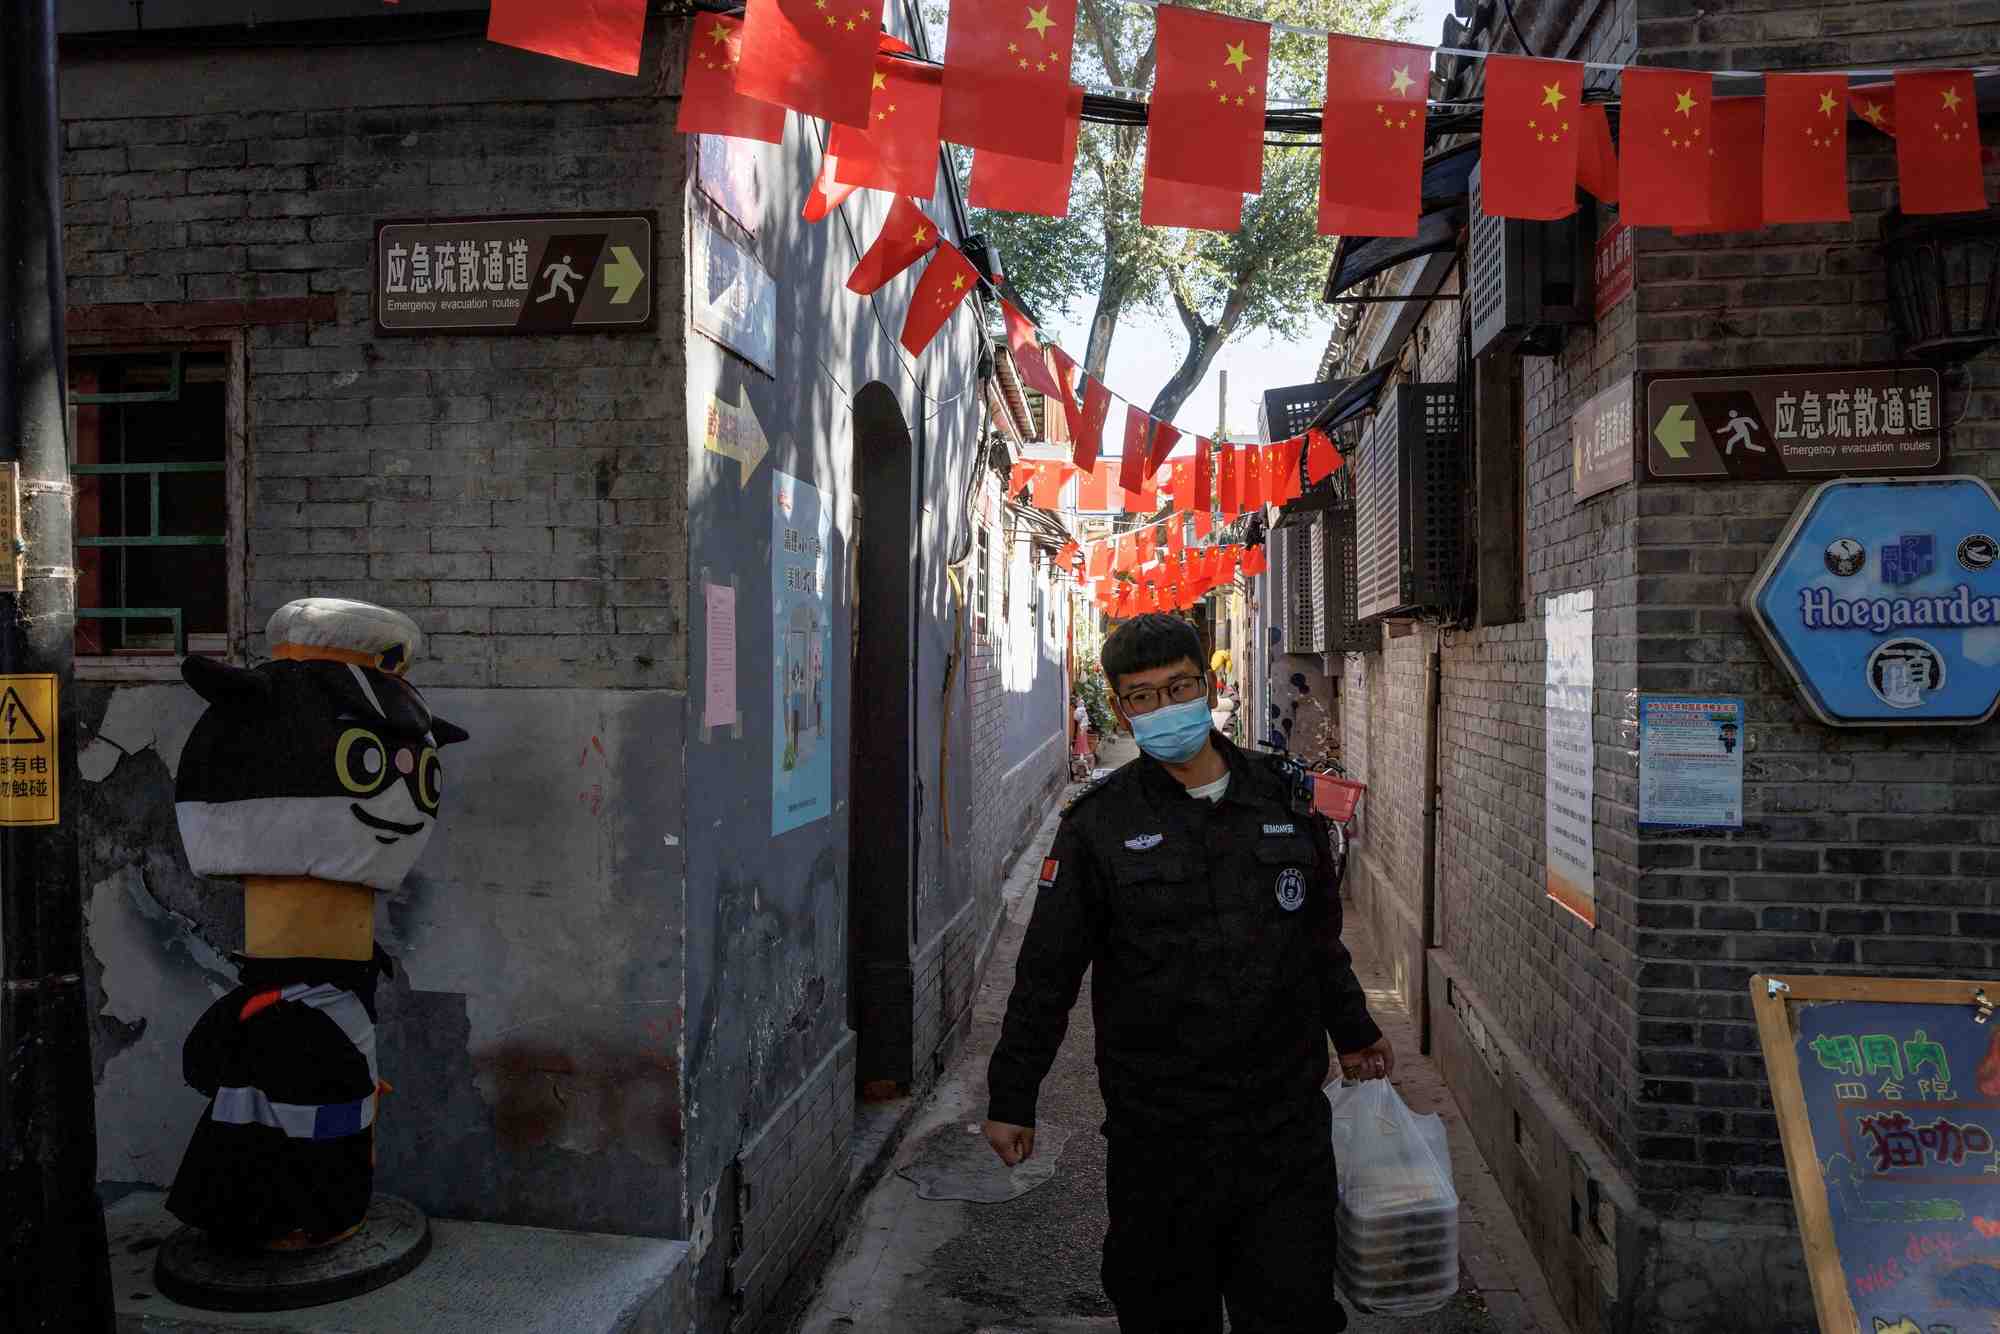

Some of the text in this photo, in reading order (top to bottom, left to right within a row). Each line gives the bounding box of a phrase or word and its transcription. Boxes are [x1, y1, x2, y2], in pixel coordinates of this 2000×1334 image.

[386, 239, 529, 294] 应急疏散通道
[387, 297, 521, 313] Emergency evacuation routes
[1774, 386, 1934, 440] 应急疏散通道
[1782, 440, 1932, 458] Emergency evacuation routes
